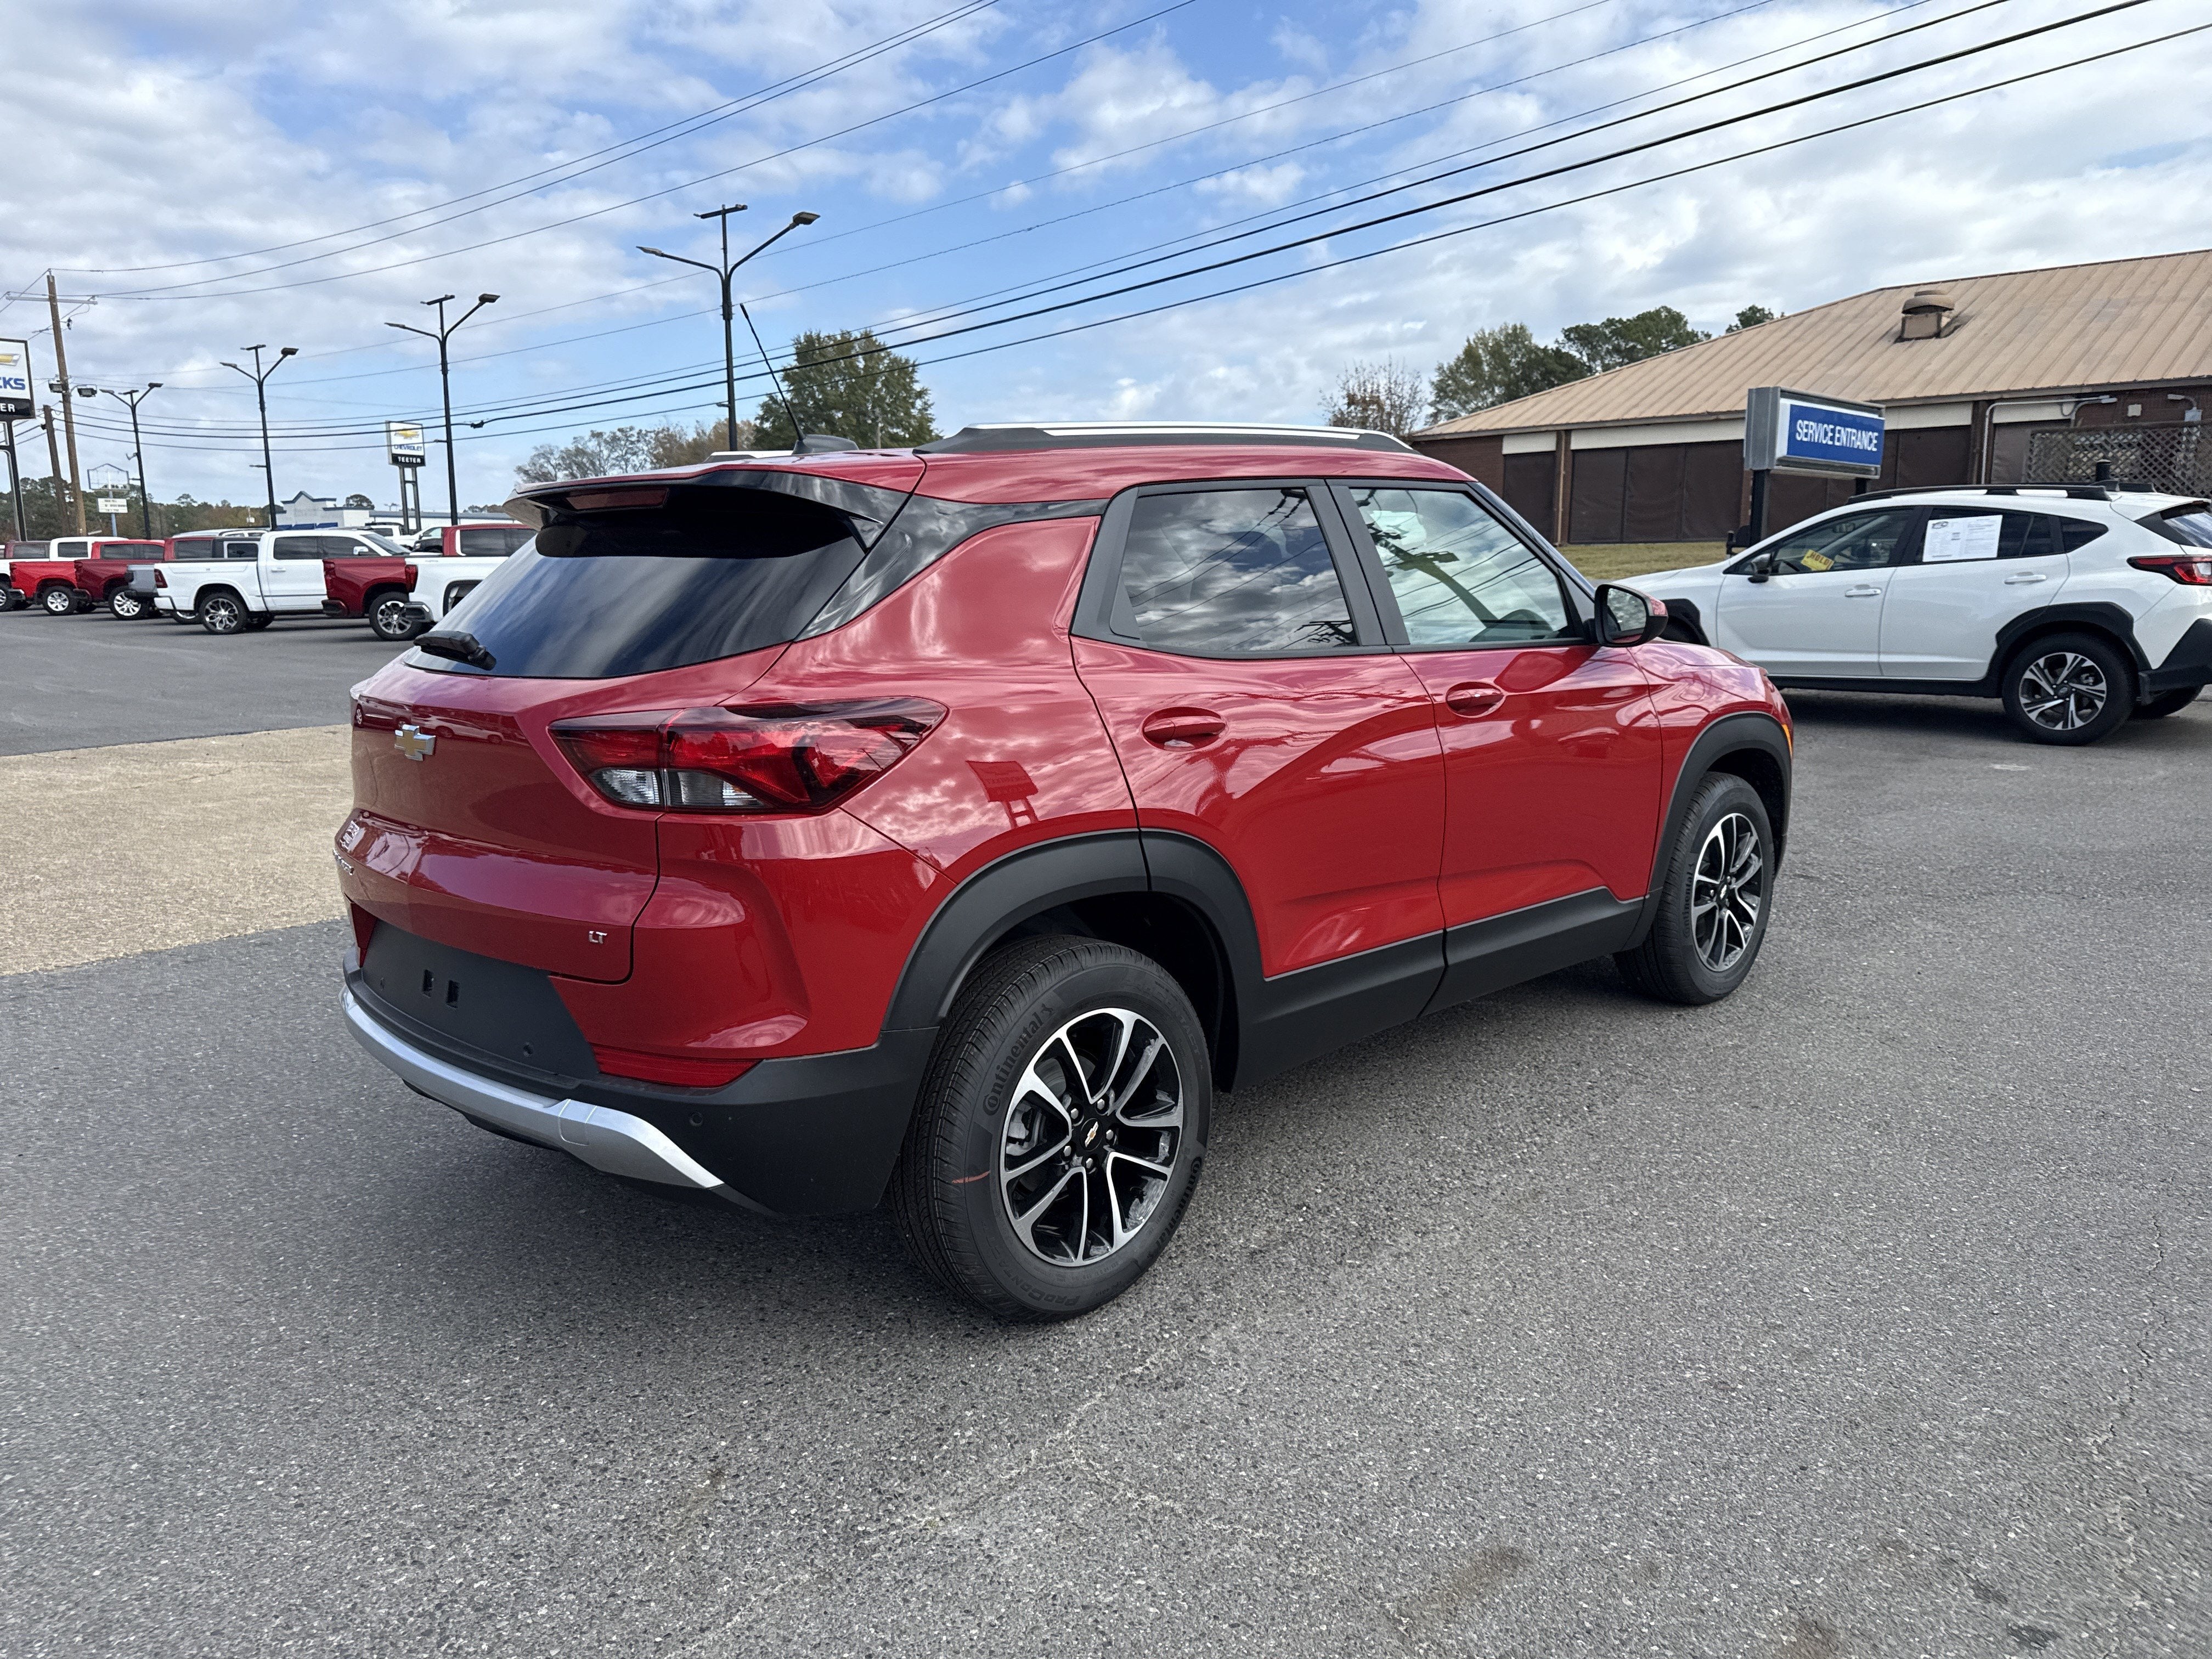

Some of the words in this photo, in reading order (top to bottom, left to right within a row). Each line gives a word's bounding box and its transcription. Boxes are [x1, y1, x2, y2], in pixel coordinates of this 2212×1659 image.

[0, 377, 25, 390] KS
[1796, 420, 1835, 445] SERVICE
[1834, 426, 1879, 452] ENTRANCE
[589, 930, 608, 944] LT
[983, 1012, 1044, 1116] Continental
